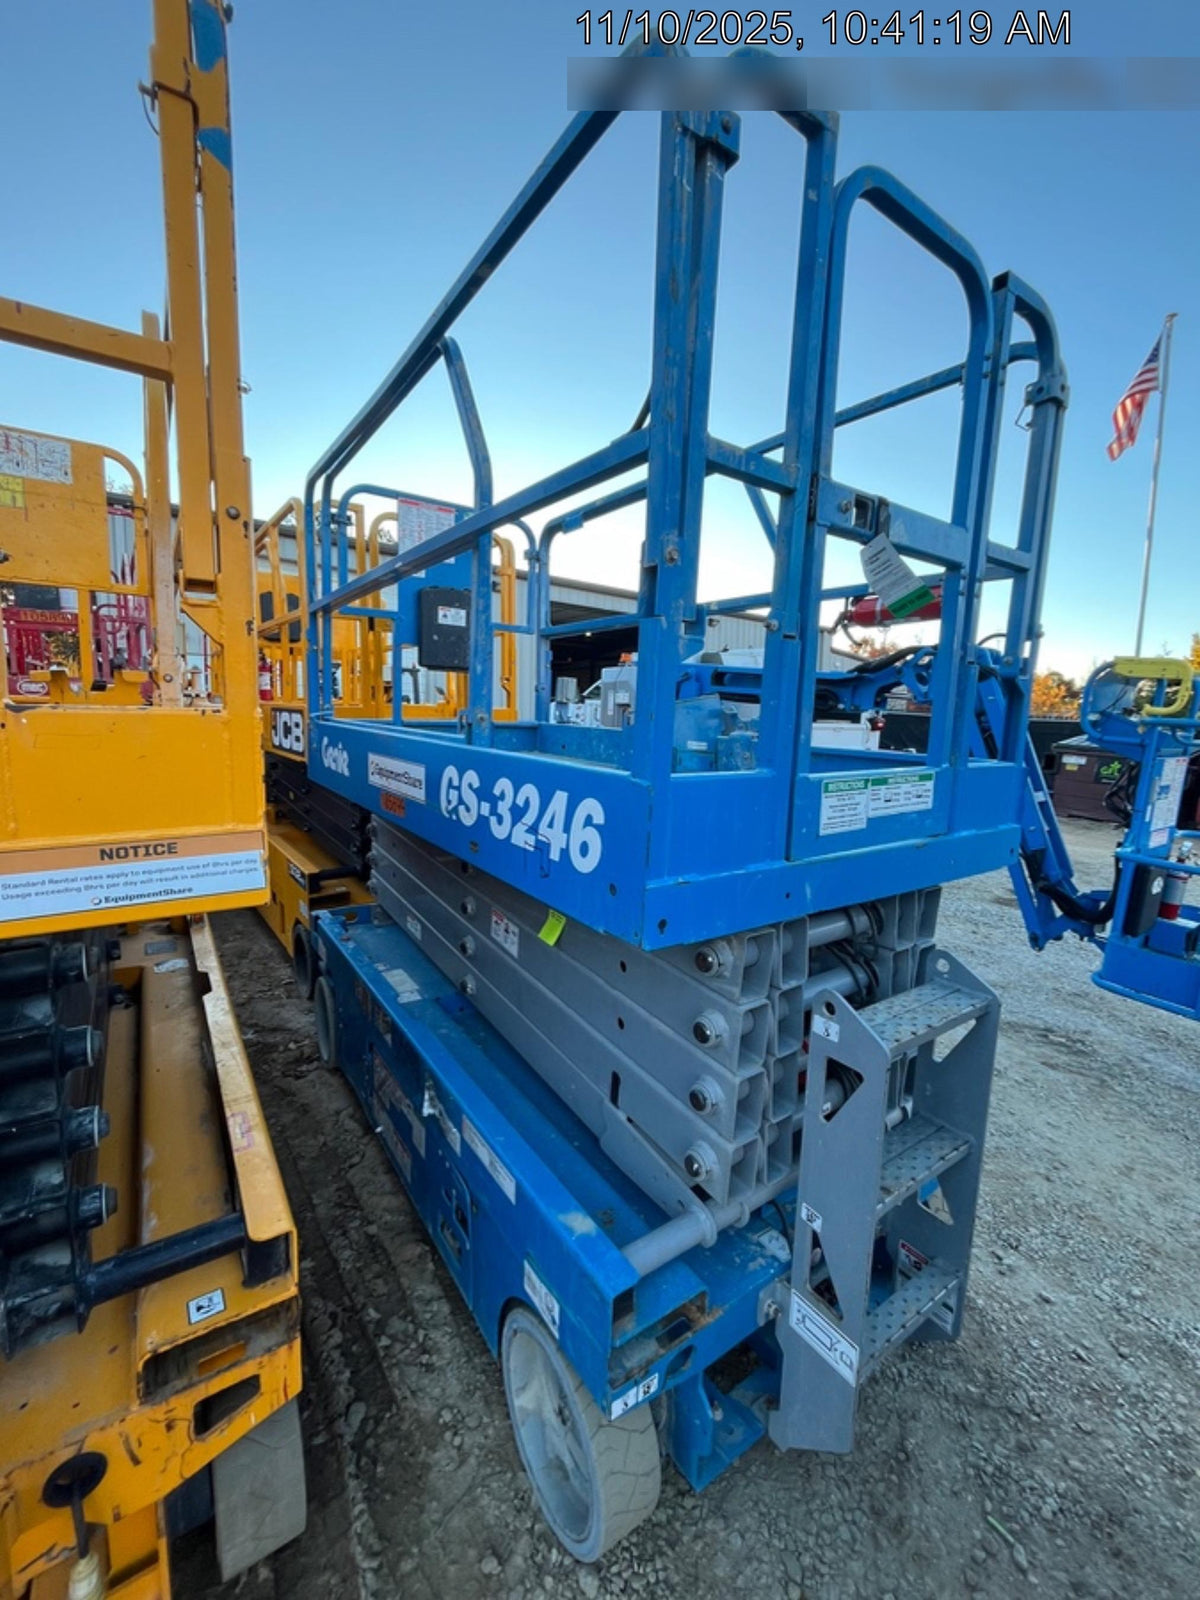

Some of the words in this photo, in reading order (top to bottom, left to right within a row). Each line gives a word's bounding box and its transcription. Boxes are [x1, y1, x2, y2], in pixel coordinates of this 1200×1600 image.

[271, 711, 304, 752] JCB
[321, 736, 350, 777] Genie
[440, 765, 605, 874] GS-3246
[99, 842, 178, 861] NOTICE
[1, 879, 46, 891] Standard
[48, 876, 79, 885] Rental
[80, 874, 104, 882] rates
[105, 871, 129, 881] apply
[130, 869, 141, 877] to
[142, 865, 185, 876] equipment
[231, 859, 242, 867] per
[1, 892, 32, 902] Usage
[34, 885, 82, 897] exceeding
[106, 881, 120, 889] per
[122, 879, 138, 888] day
[140, 877, 153, 885] will
[156, 875, 179, 883] result
[190, 870, 228, 879] additional
[104, 887, 193, 904] EquipmentShare
